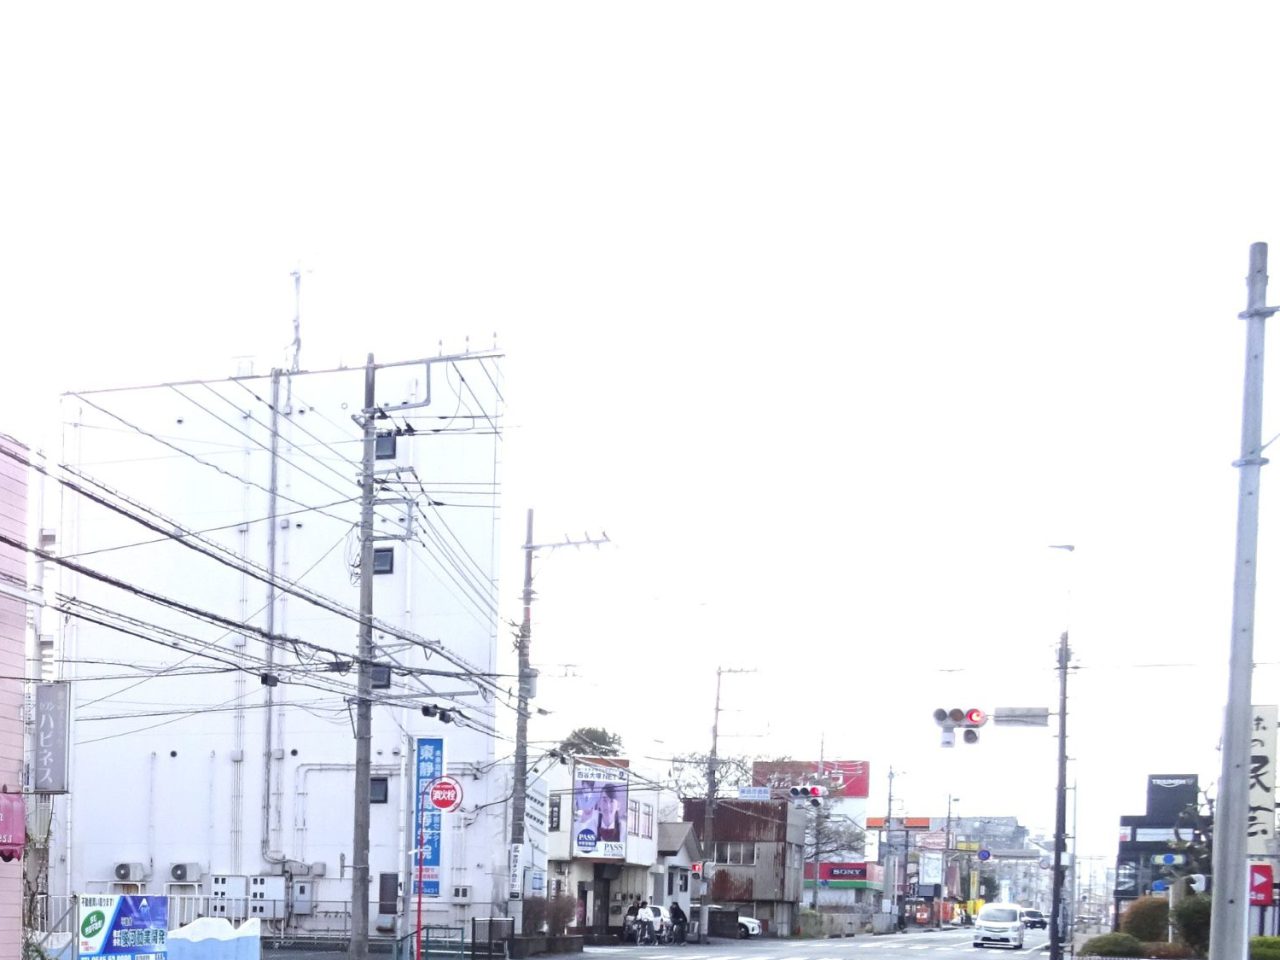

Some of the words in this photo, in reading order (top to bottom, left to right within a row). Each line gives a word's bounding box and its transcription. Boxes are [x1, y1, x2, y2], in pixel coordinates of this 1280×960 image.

[432, 789, 456, 801] 消火栓
[604, 843, 624, 851] PASS
